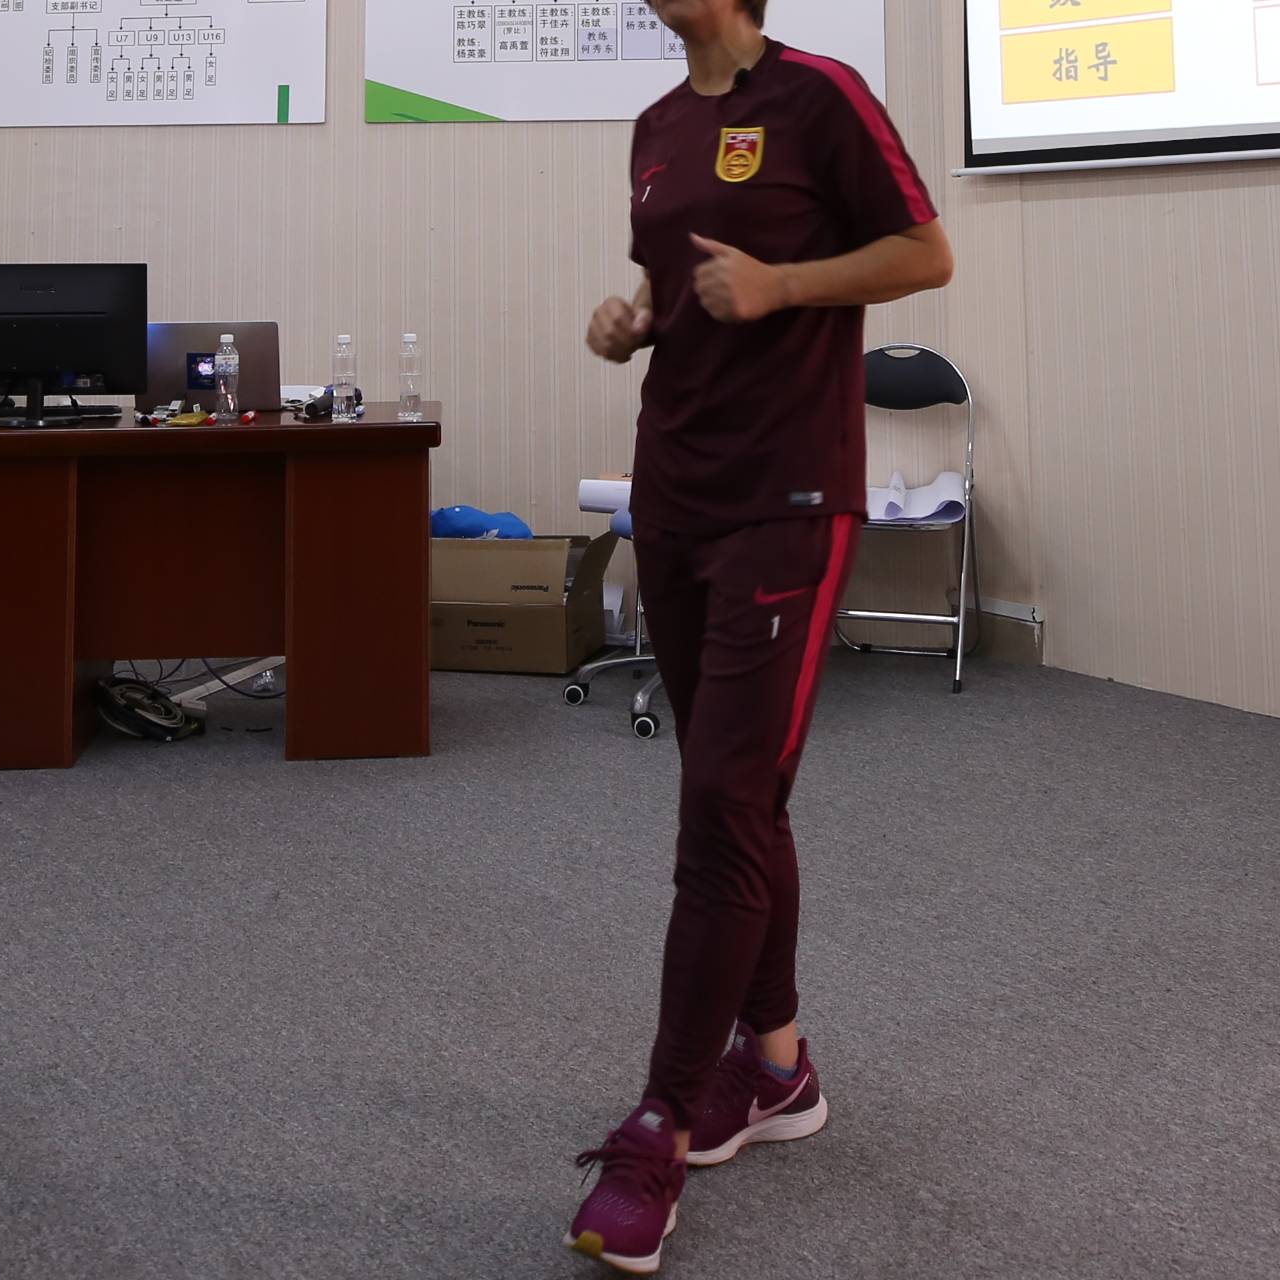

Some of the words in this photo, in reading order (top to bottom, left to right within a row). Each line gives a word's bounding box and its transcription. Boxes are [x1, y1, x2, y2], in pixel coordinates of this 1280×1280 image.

[51, 0, 98, 12] 支部副书记
[580, 18, 601, 28] 杨斌
[625, 20, 658, 31] 杨英豪
[116, 35, 129, 43] U7
[145, 33, 159, 42] U9
[173, 33, 192, 41] U13
[202, 32, 220, 41] U16
[587, 31, 608, 41] 教练
[457, 49, 486, 59] 杨英豪
[539, 47, 570, 58] 符建翔
[581, 44, 614, 55] 何秀东
[1051, 42, 1118, 82] 指导
[207, 60, 215, 83] 女足
[108, 75, 116, 98] 女足
[124, 75, 133, 97] 男足
[138, 75, 147, 97] 女足
[154, 75, 163, 97] 男足
[168, 74, 176, 97] 女足
[185, 74, 193, 97] 男足
[770, 615, 781, 640] 1
